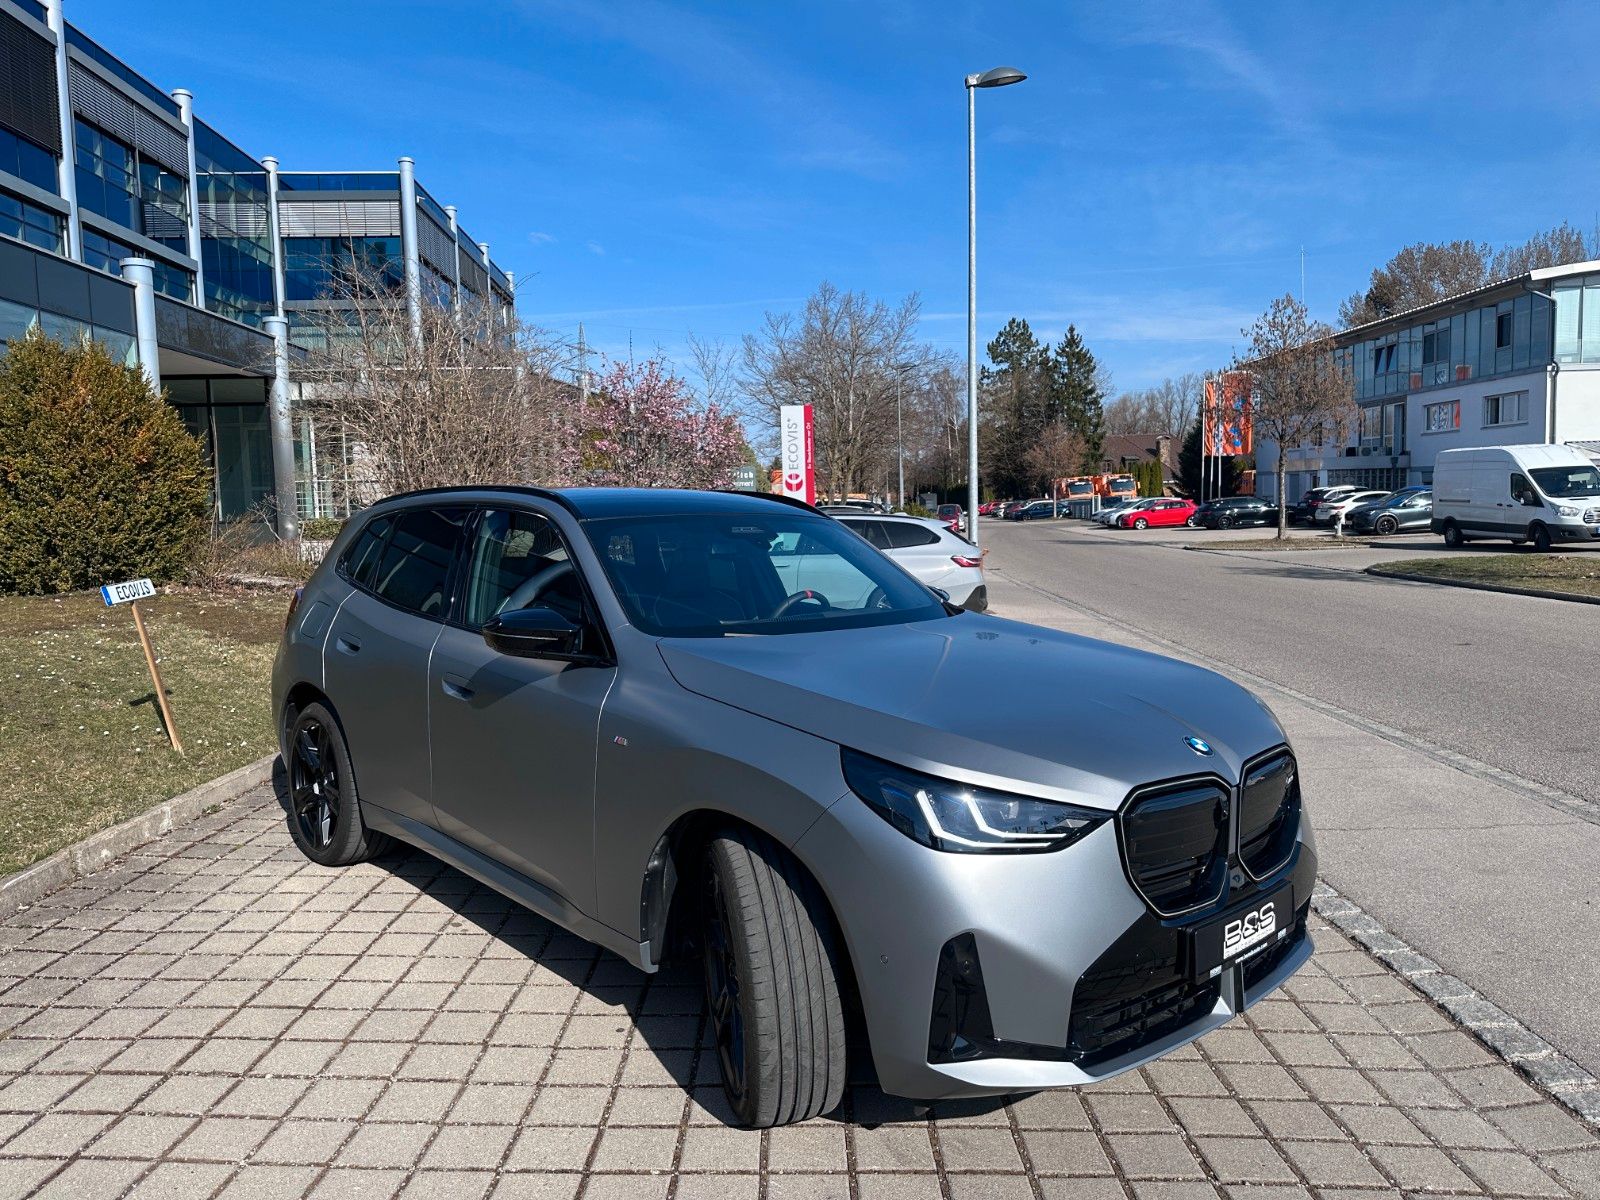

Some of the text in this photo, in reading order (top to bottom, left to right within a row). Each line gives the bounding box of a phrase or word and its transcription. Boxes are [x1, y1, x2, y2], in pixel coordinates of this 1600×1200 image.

[787, 422, 799, 470] ECOVIS
[115, 581, 151, 600] ECOVIS
[1224, 902, 1276, 949] B&S
